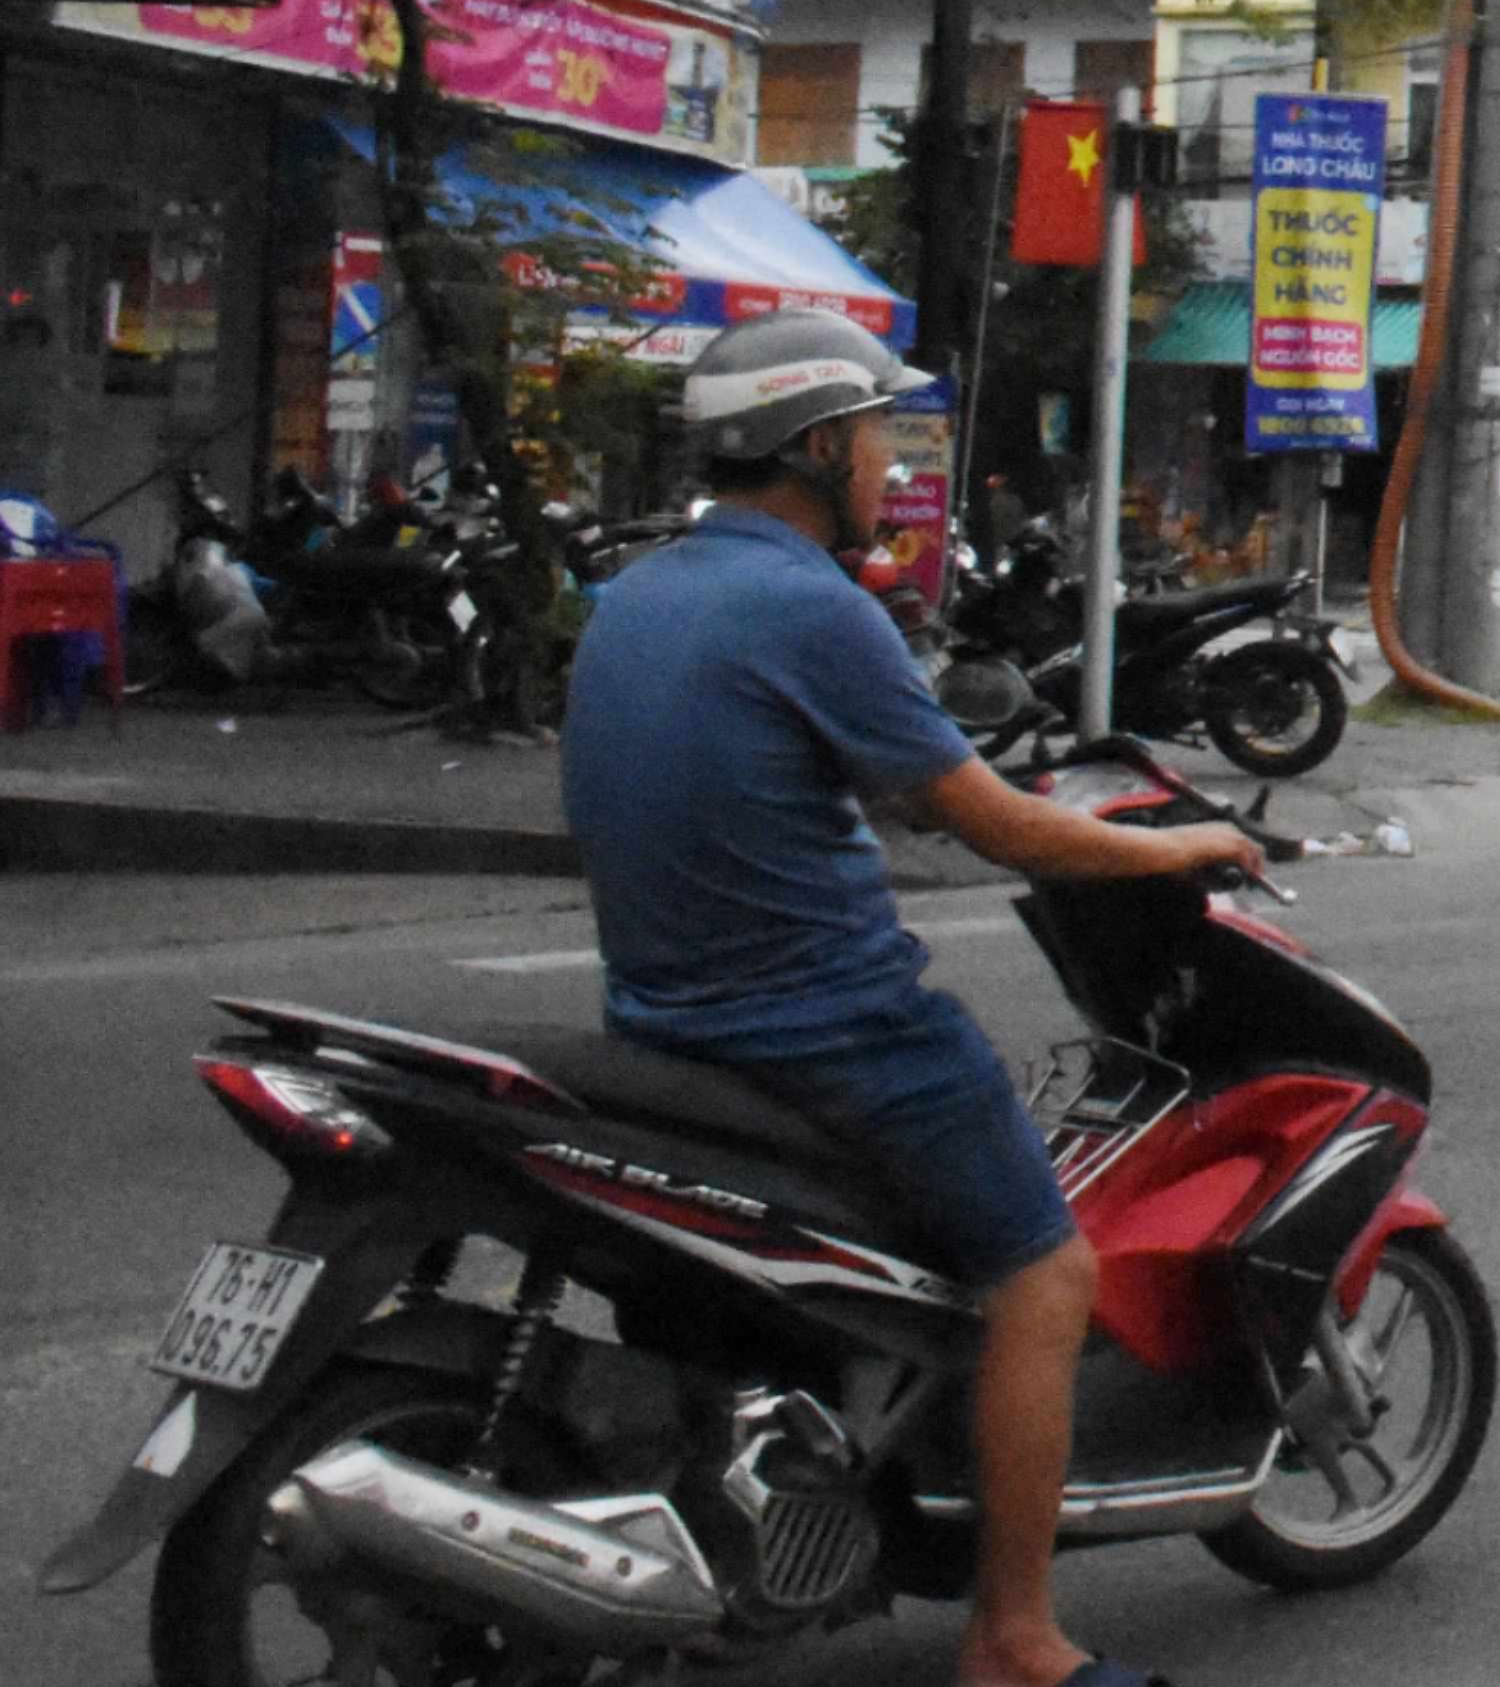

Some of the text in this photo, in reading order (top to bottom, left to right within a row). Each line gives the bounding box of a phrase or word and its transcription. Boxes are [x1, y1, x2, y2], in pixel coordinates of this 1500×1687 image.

[1261, 155, 1377, 181] LONG CHÂU
[1268, 205, 1359, 238] THUỐC
[1272, 240, 1353, 270] CHÍNH
[619, 1163, 770, 1220] BLADE
[206, 1249, 299, 1318] 76-H1
